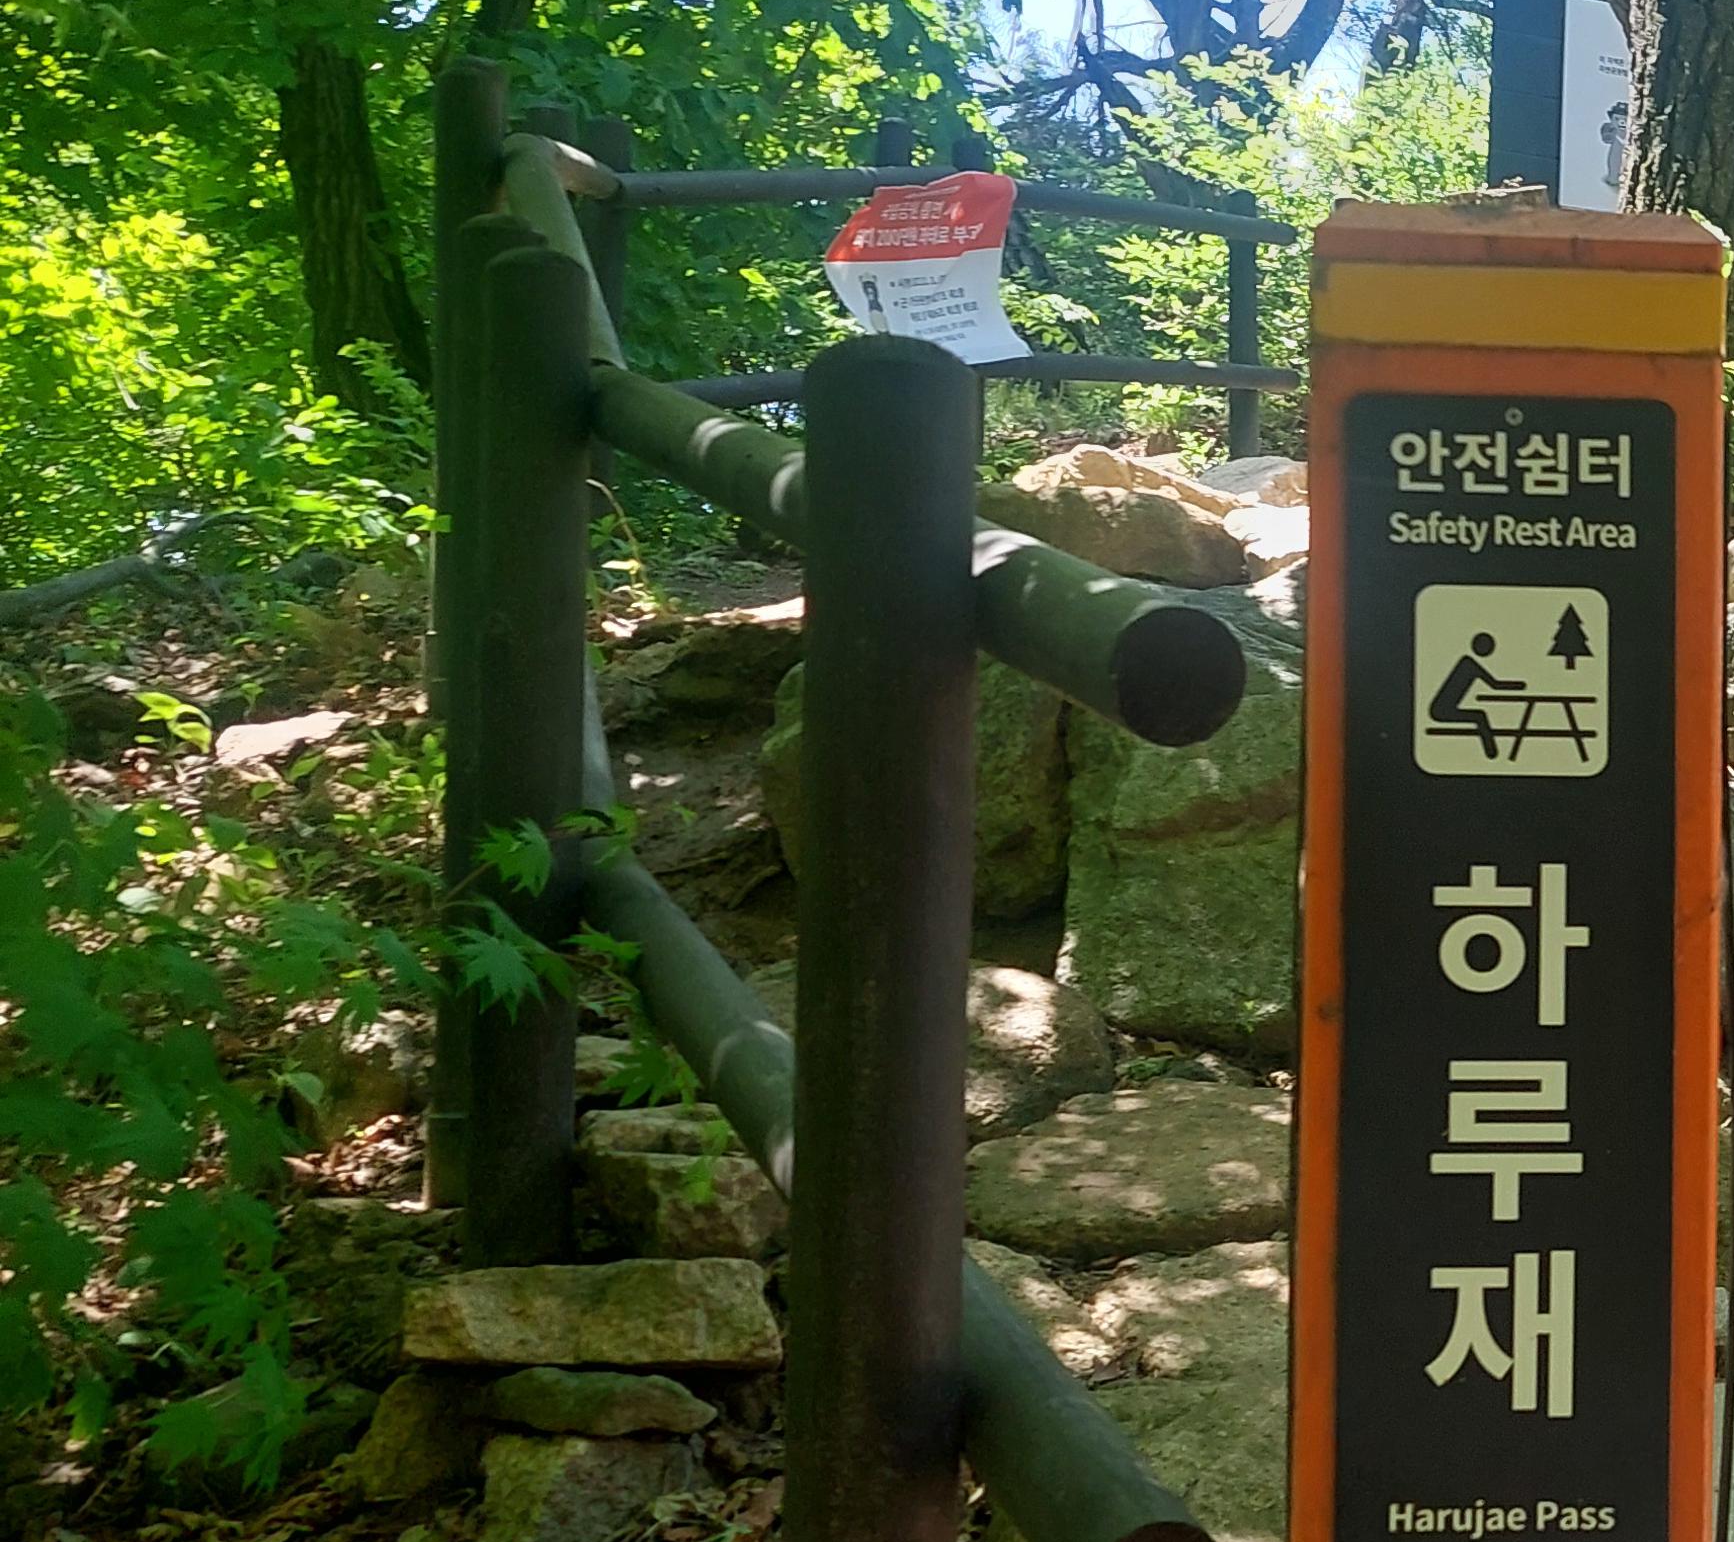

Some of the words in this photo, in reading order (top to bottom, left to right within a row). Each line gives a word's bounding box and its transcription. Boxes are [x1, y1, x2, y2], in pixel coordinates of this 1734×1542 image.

[1389, 428, 1632, 498] 안전쉼터
[1388, 510, 1489, 552] Safety
[1493, 513, 1563, 548] Rest
[1565, 516, 1637, 549] Area
[1423, 862, 1591, 1419] 하루재
[1387, 1499, 1528, 1539] Harujae
[1535, 1500, 1616, 1532] Pass
